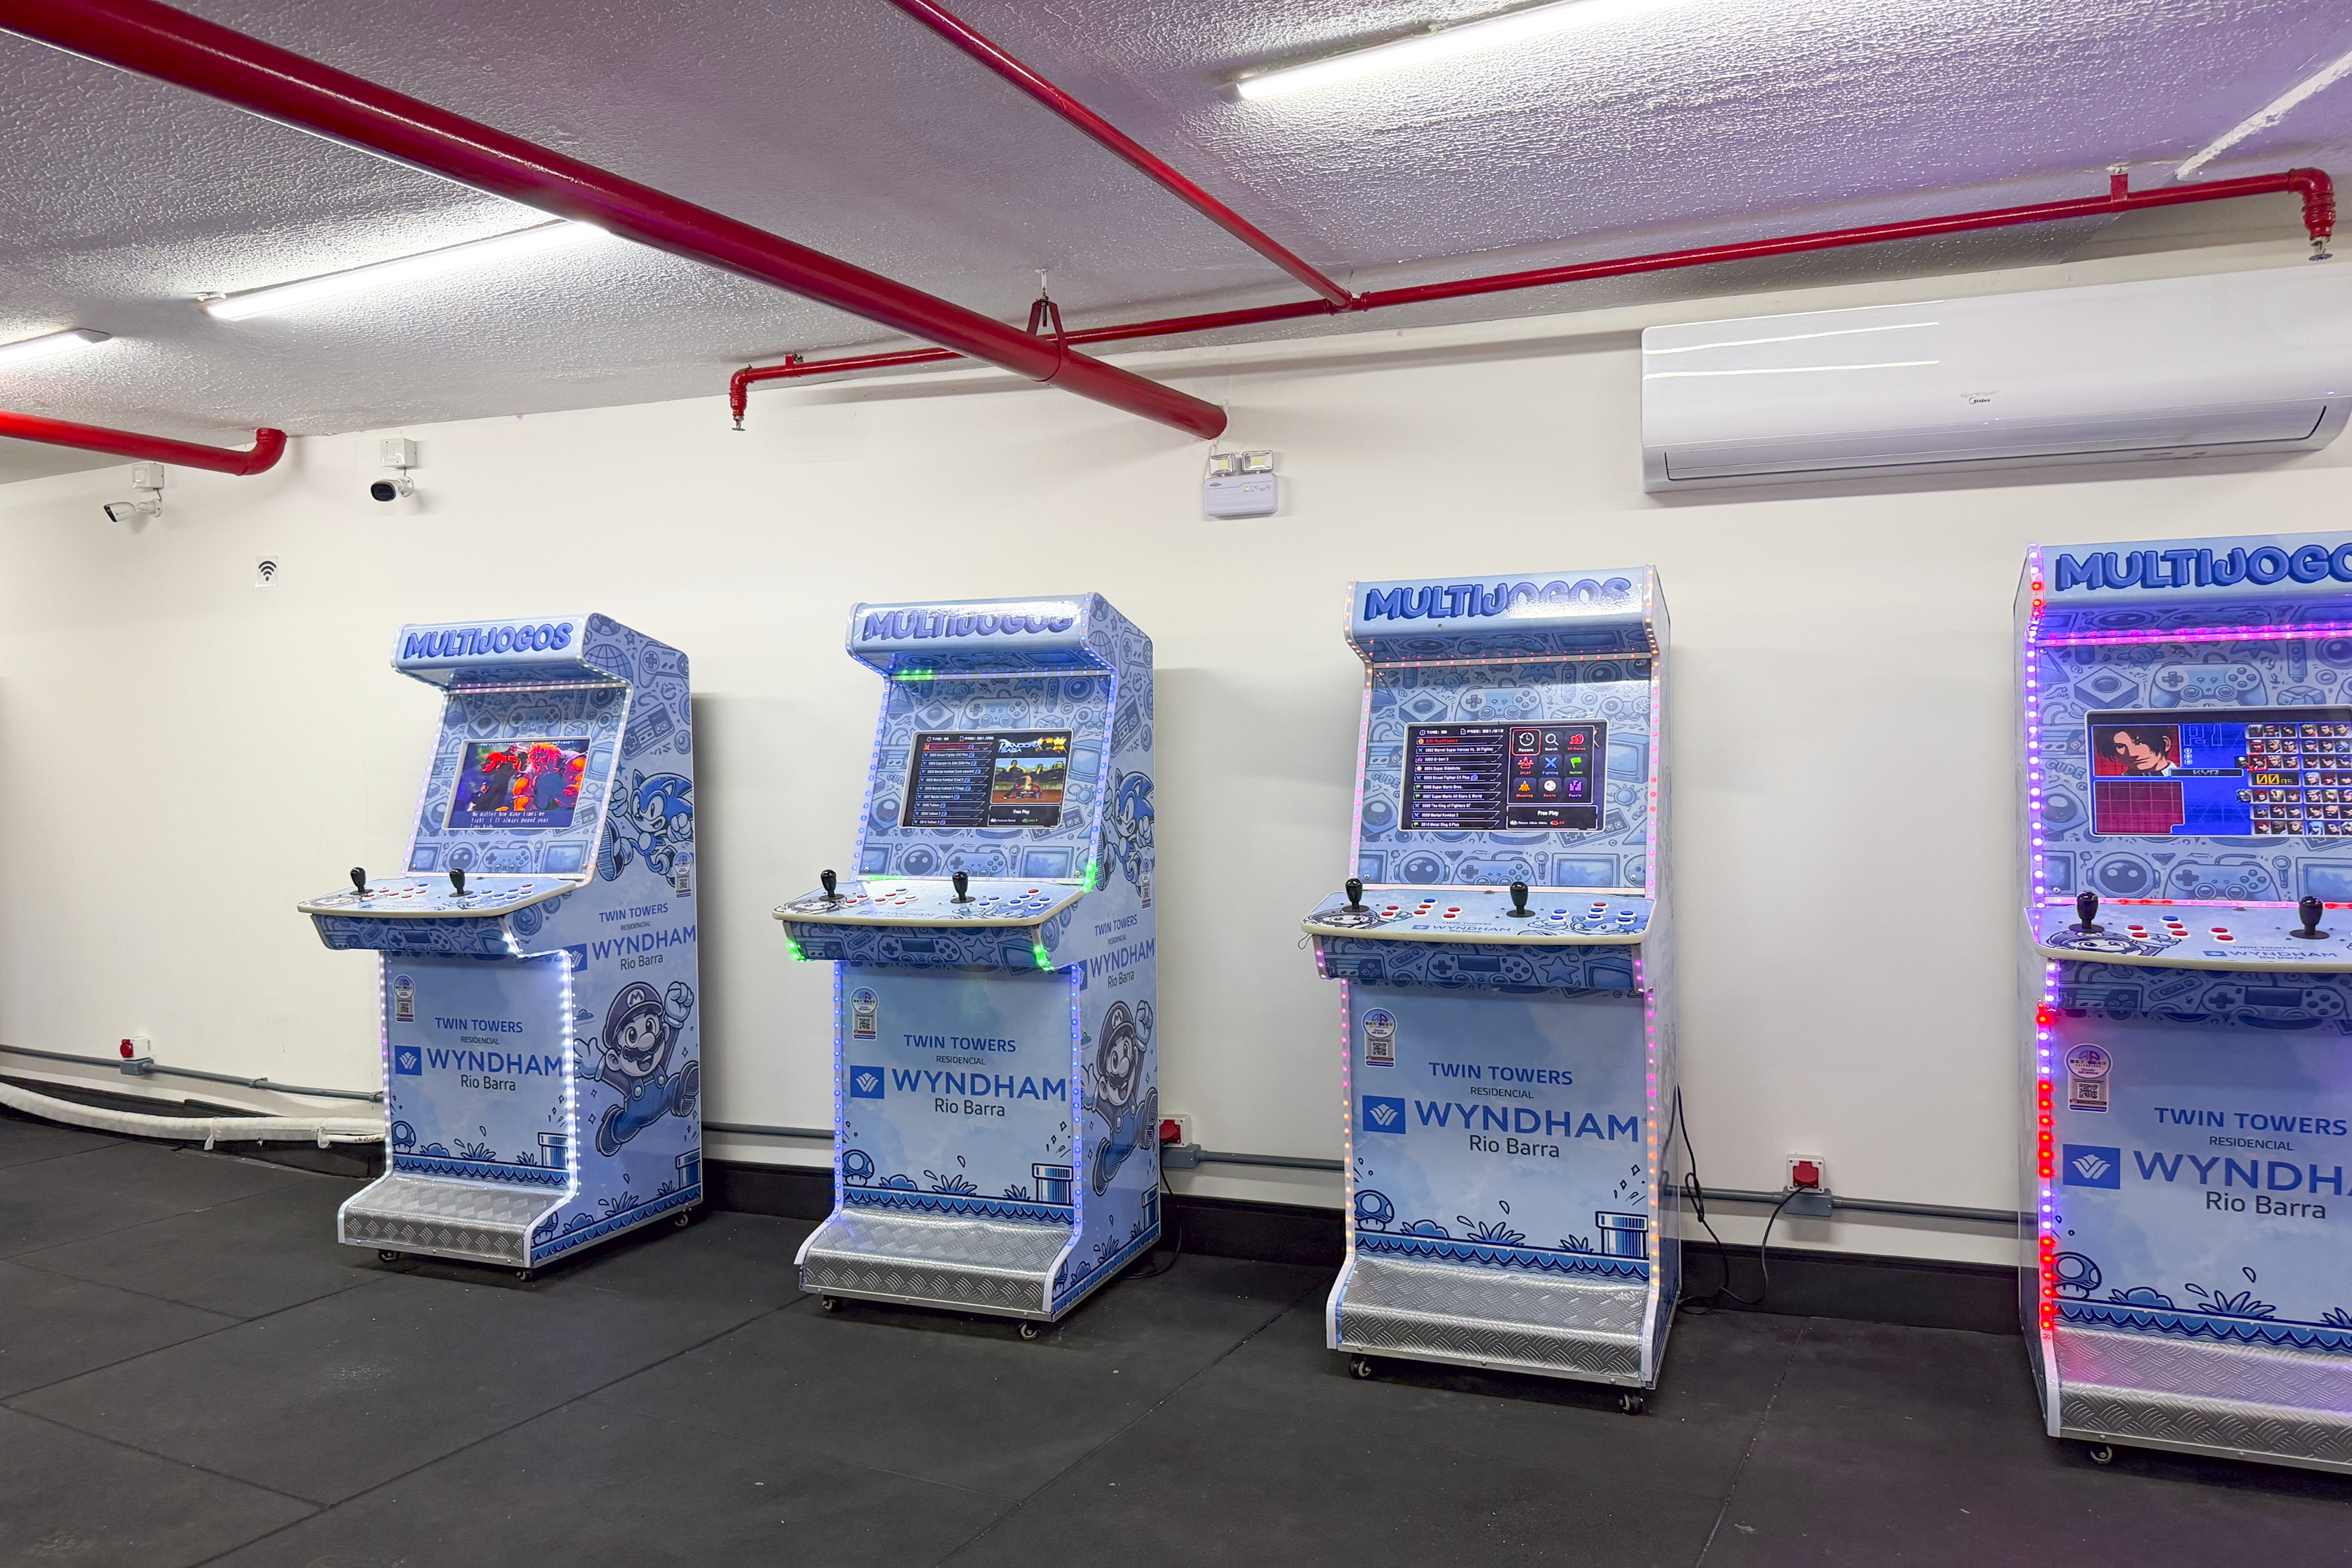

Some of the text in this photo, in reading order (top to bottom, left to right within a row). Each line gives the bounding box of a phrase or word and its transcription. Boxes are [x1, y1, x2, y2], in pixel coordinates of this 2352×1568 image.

[1364, 577, 1631, 621] MULTIJOGOS
[403, 622, 574, 659] MULTIJOGOS
[599, 903, 668, 922] TWIN TOWERS
[621, 921, 651, 931] RESIDENCIAL
[1095, 914, 1137, 936] TWIN TOWERS
[592, 925, 696, 960] WYNDHAM
[621, 954, 663, 971] Rio Barra
[1090, 938, 1155, 978] WYNDHAM
[1108, 970, 1134, 989] Rio Barra
[435, 1017, 524, 1033] TWIN TOWERS
[461, 1035, 500, 1045] RESIDENCIAL
[904, 1035, 1017, 1053] TWIN TOWERS
[426, 1048, 564, 1077] WYNDHAM
[935, 1055, 986, 1066] RESIDENCIAL
[461, 1074, 516, 1091] Rio Barra
[891, 1068, 1066, 1102] WYNDHAM
[1429, 1062, 1574, 1086] TWIN TOWERS
[1470, 1086, 1534, 1099] RESIDENCIAL
[934, 1098, 1005, 1117] Rio Barra
[1414, 1100, 1639, 1142] WYNDHAM
[2154, 1107, 2347, 1136] TWIN TOWERS
[1469, 1134, 1560, 1158] Rio Barra
[2209, 1136, 2294, 1152] RESIDENCIAL
[2133, 1150, 2352, 1197] WYNDH
[2206, 1191, 2326, 1220] Rio Barra
